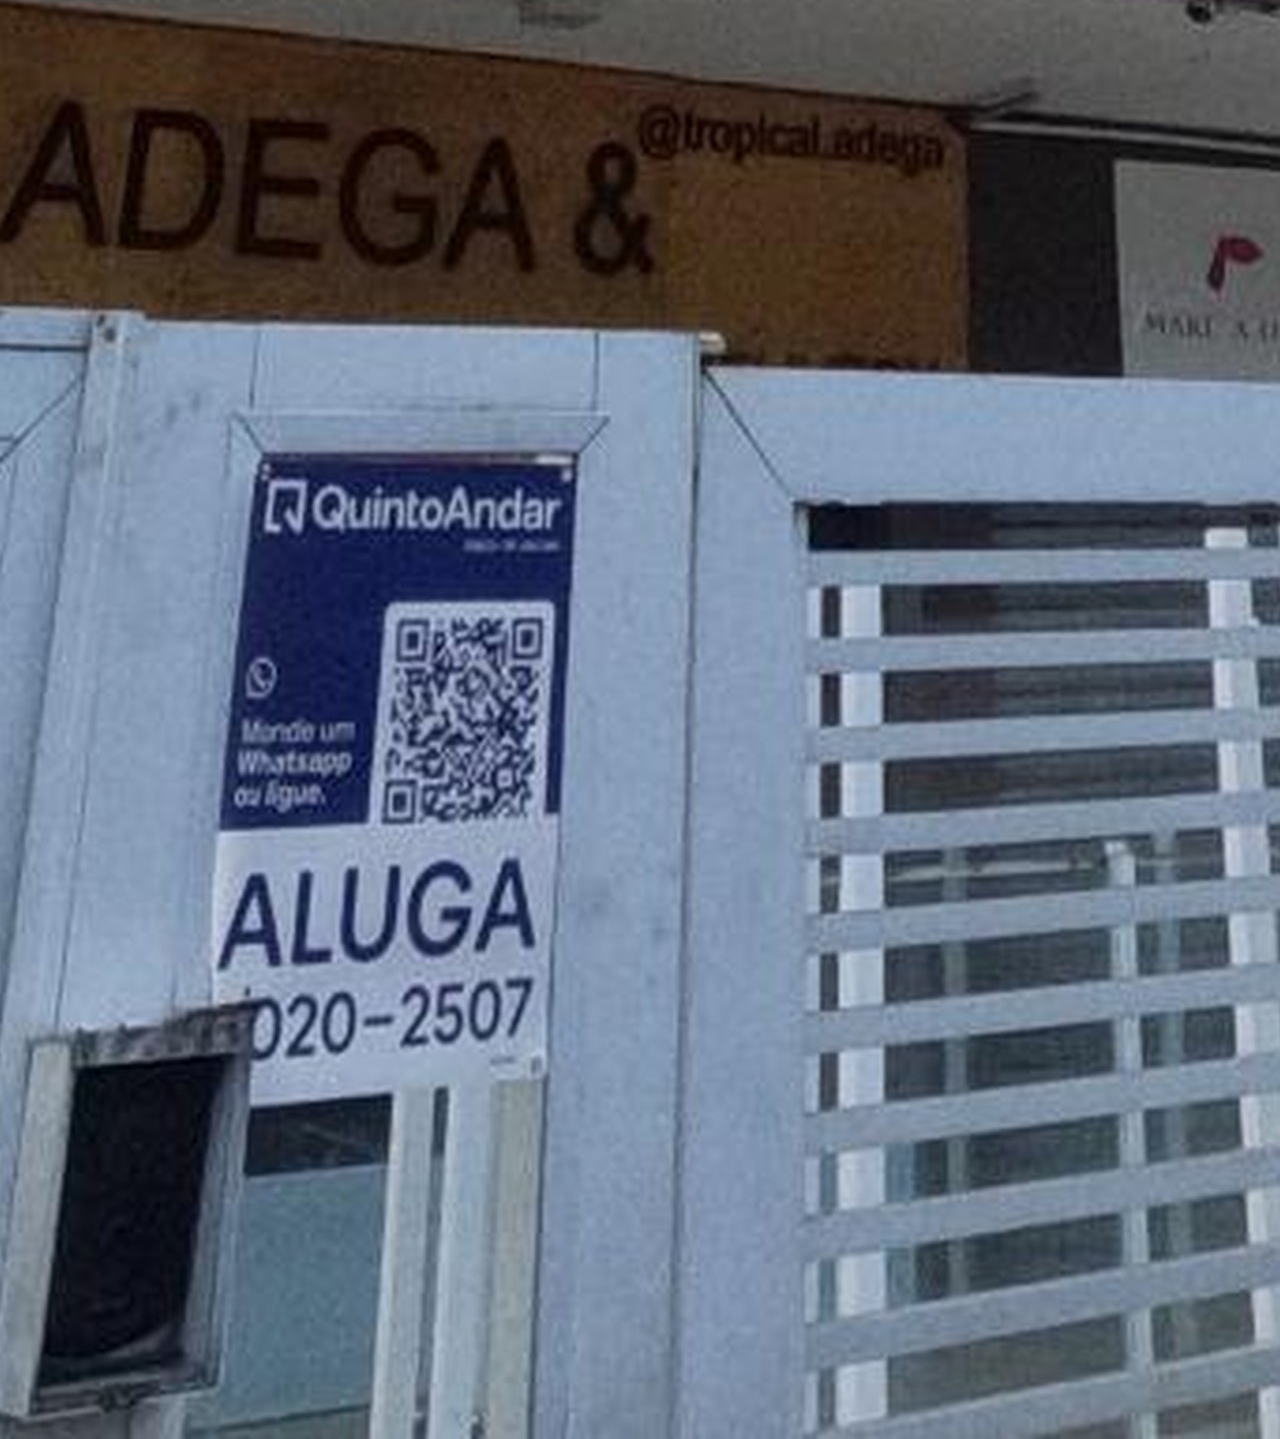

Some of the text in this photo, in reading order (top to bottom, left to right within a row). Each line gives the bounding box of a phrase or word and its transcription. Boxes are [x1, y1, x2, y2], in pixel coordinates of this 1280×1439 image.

[573, 141, 654, 275] &
[312, 484, 563, 533] QuintoAndar
[217, 857, 536, 970] ALUGA
